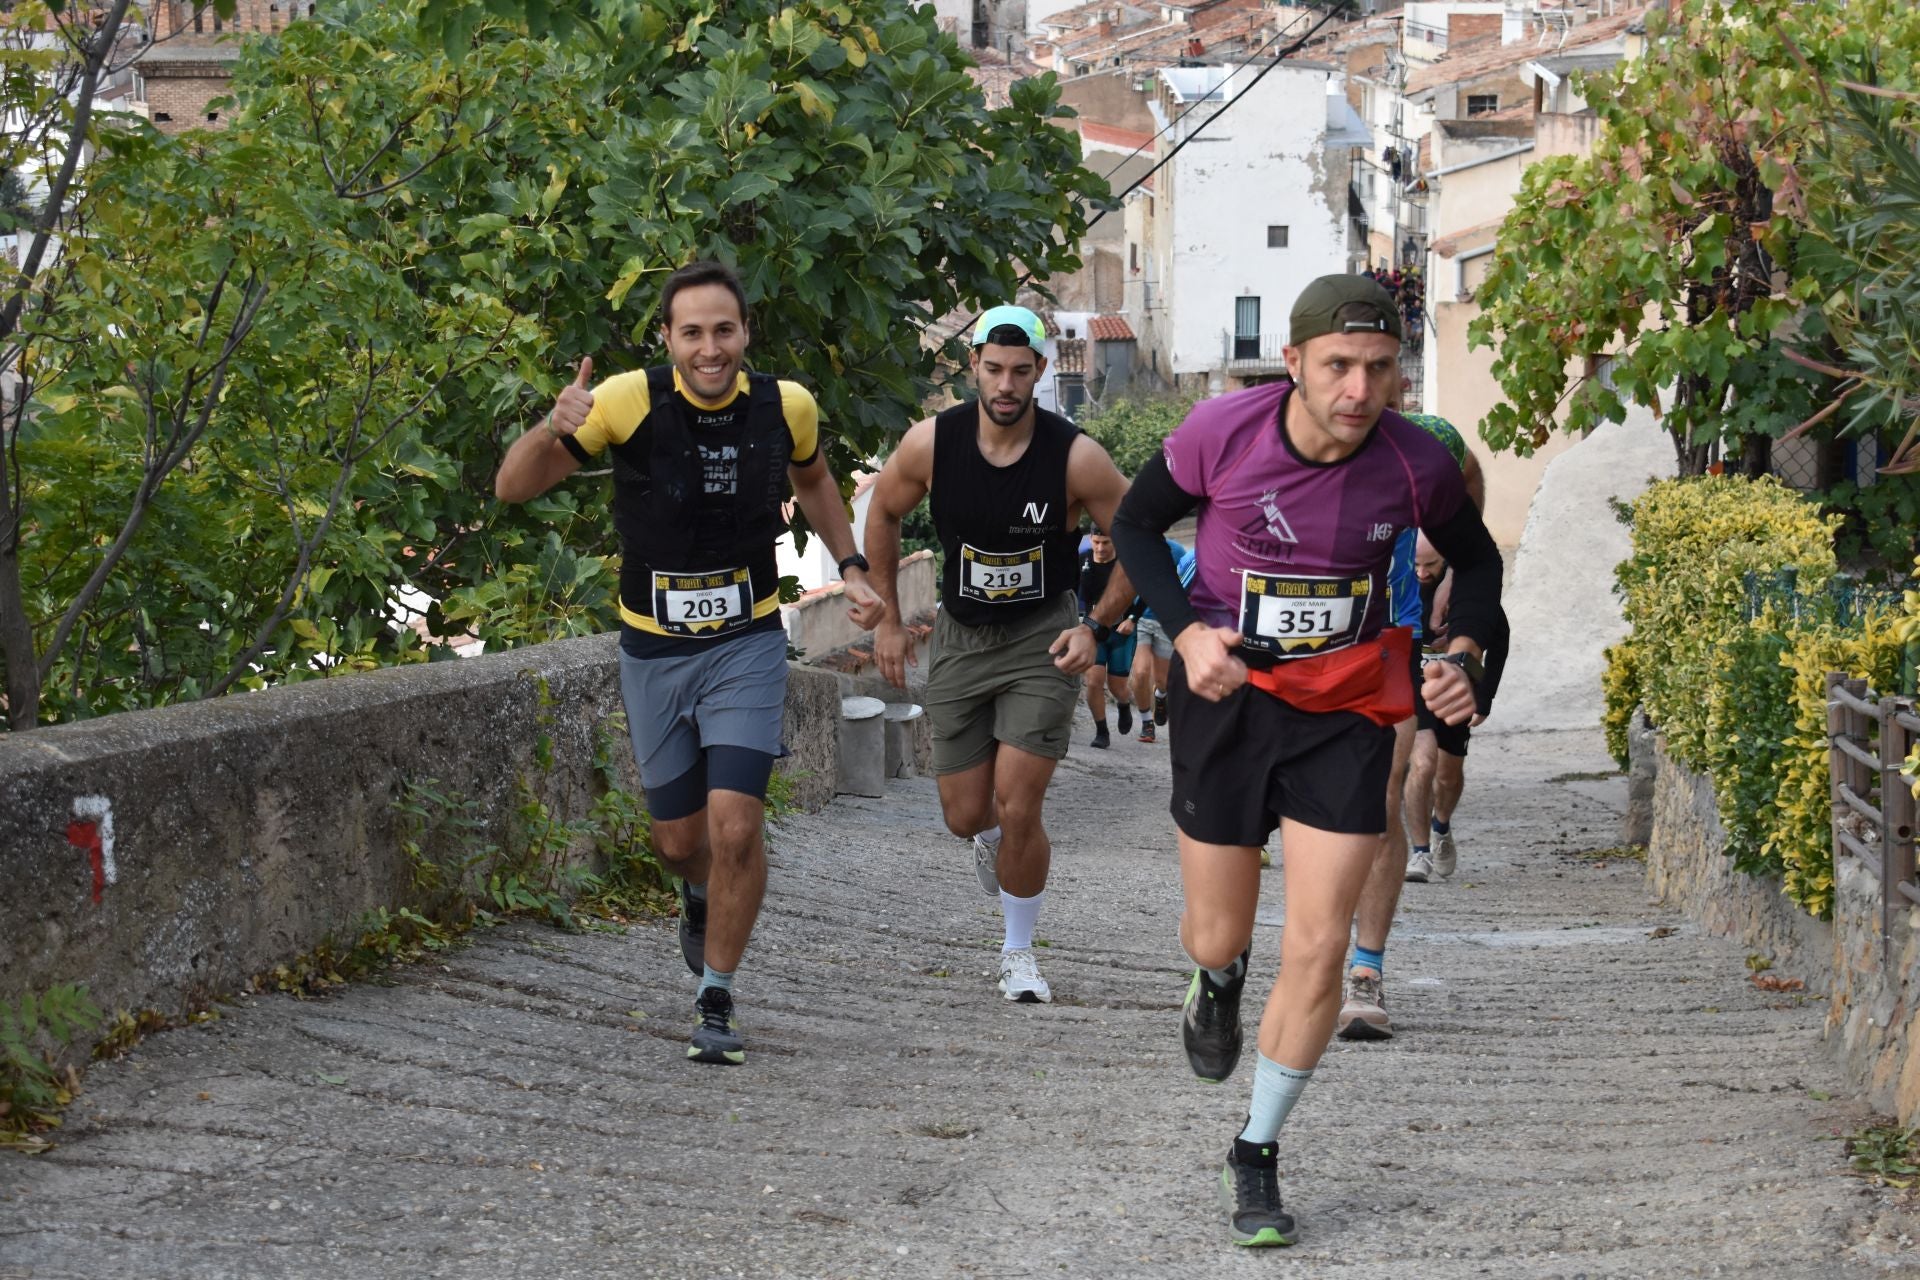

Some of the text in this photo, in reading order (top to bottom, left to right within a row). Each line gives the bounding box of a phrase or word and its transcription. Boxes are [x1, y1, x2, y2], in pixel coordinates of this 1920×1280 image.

[983, 572, 1022, 588] 219
[1275, 581, 1310, 596] TRAIL
[682, 597, 728, 619] 203
[1277, 609, 1334, 634] 351
